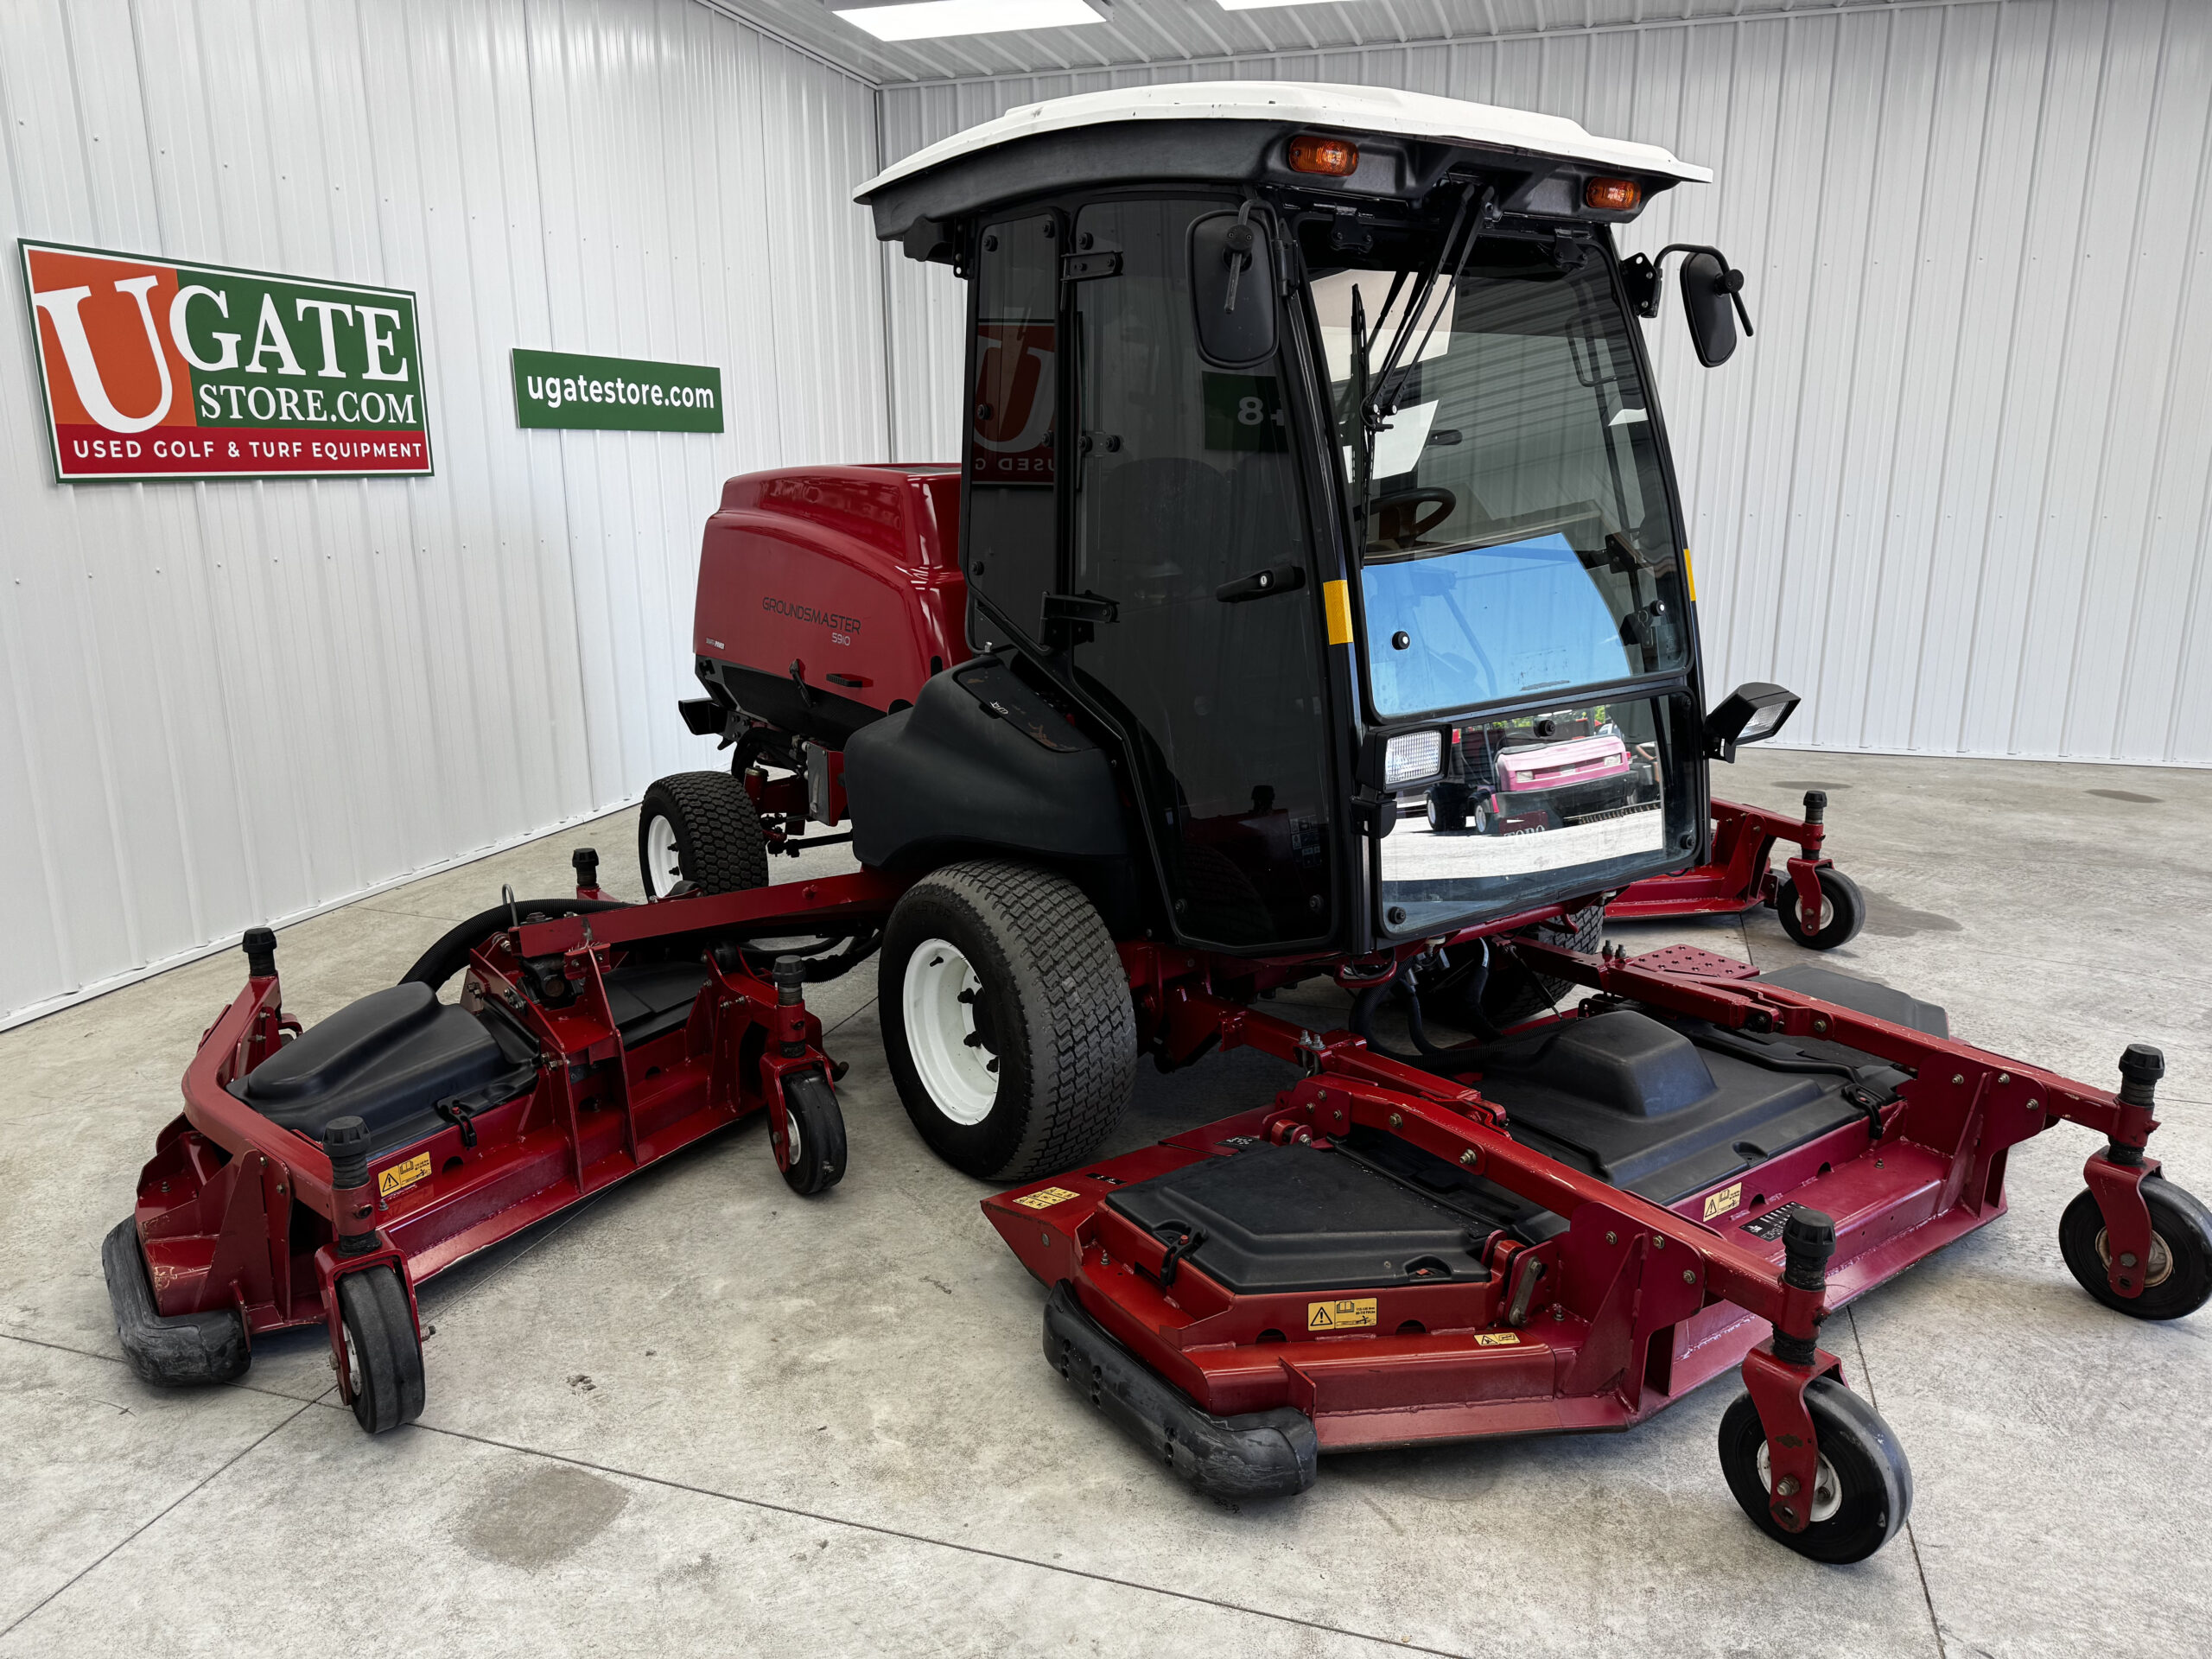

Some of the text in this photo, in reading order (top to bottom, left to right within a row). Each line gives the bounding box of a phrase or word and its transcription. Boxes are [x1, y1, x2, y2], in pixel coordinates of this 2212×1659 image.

[35, 275, 409, 433] UGATE
[199, 384, 416, 423] STORE.COM
[527, 375, 715, 409] ugatestore.com
[73, 440, 422, 460] USED GOLF & TURF EQUIPMENT
[762, 597, 861, 634] GROUNDSMASTER
